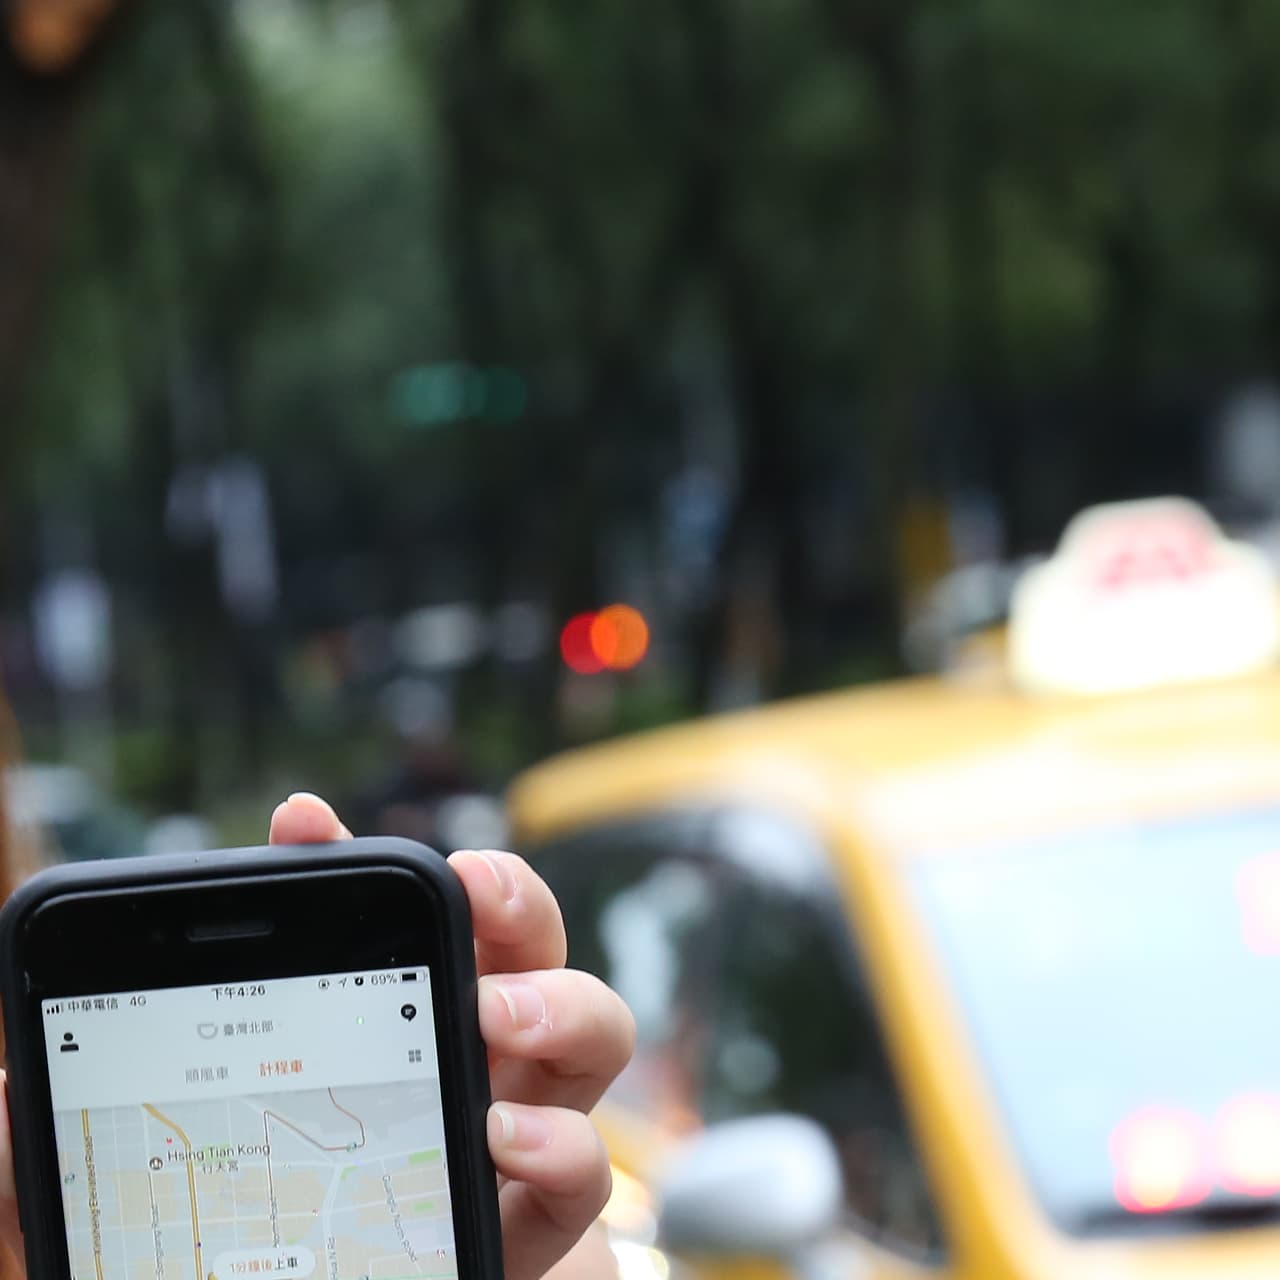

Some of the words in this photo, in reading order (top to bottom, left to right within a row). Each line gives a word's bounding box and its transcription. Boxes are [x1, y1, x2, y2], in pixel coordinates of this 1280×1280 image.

[370, 974, 397, 986] 69%
[211, 984, 266, 1000] 下午4:26
[68, 997, 119, 1013] 中華電信
[129, 995, 147, 1007] 4G
[259, 1059, 304, 1077] 計程車
[167, 1149, 204, 1162] Hsing
[207, 1147, 235, 1159] Tian
[237, 1143, 271, 1156] Kong
[202, 1161, 239, 1175] 行天宮
